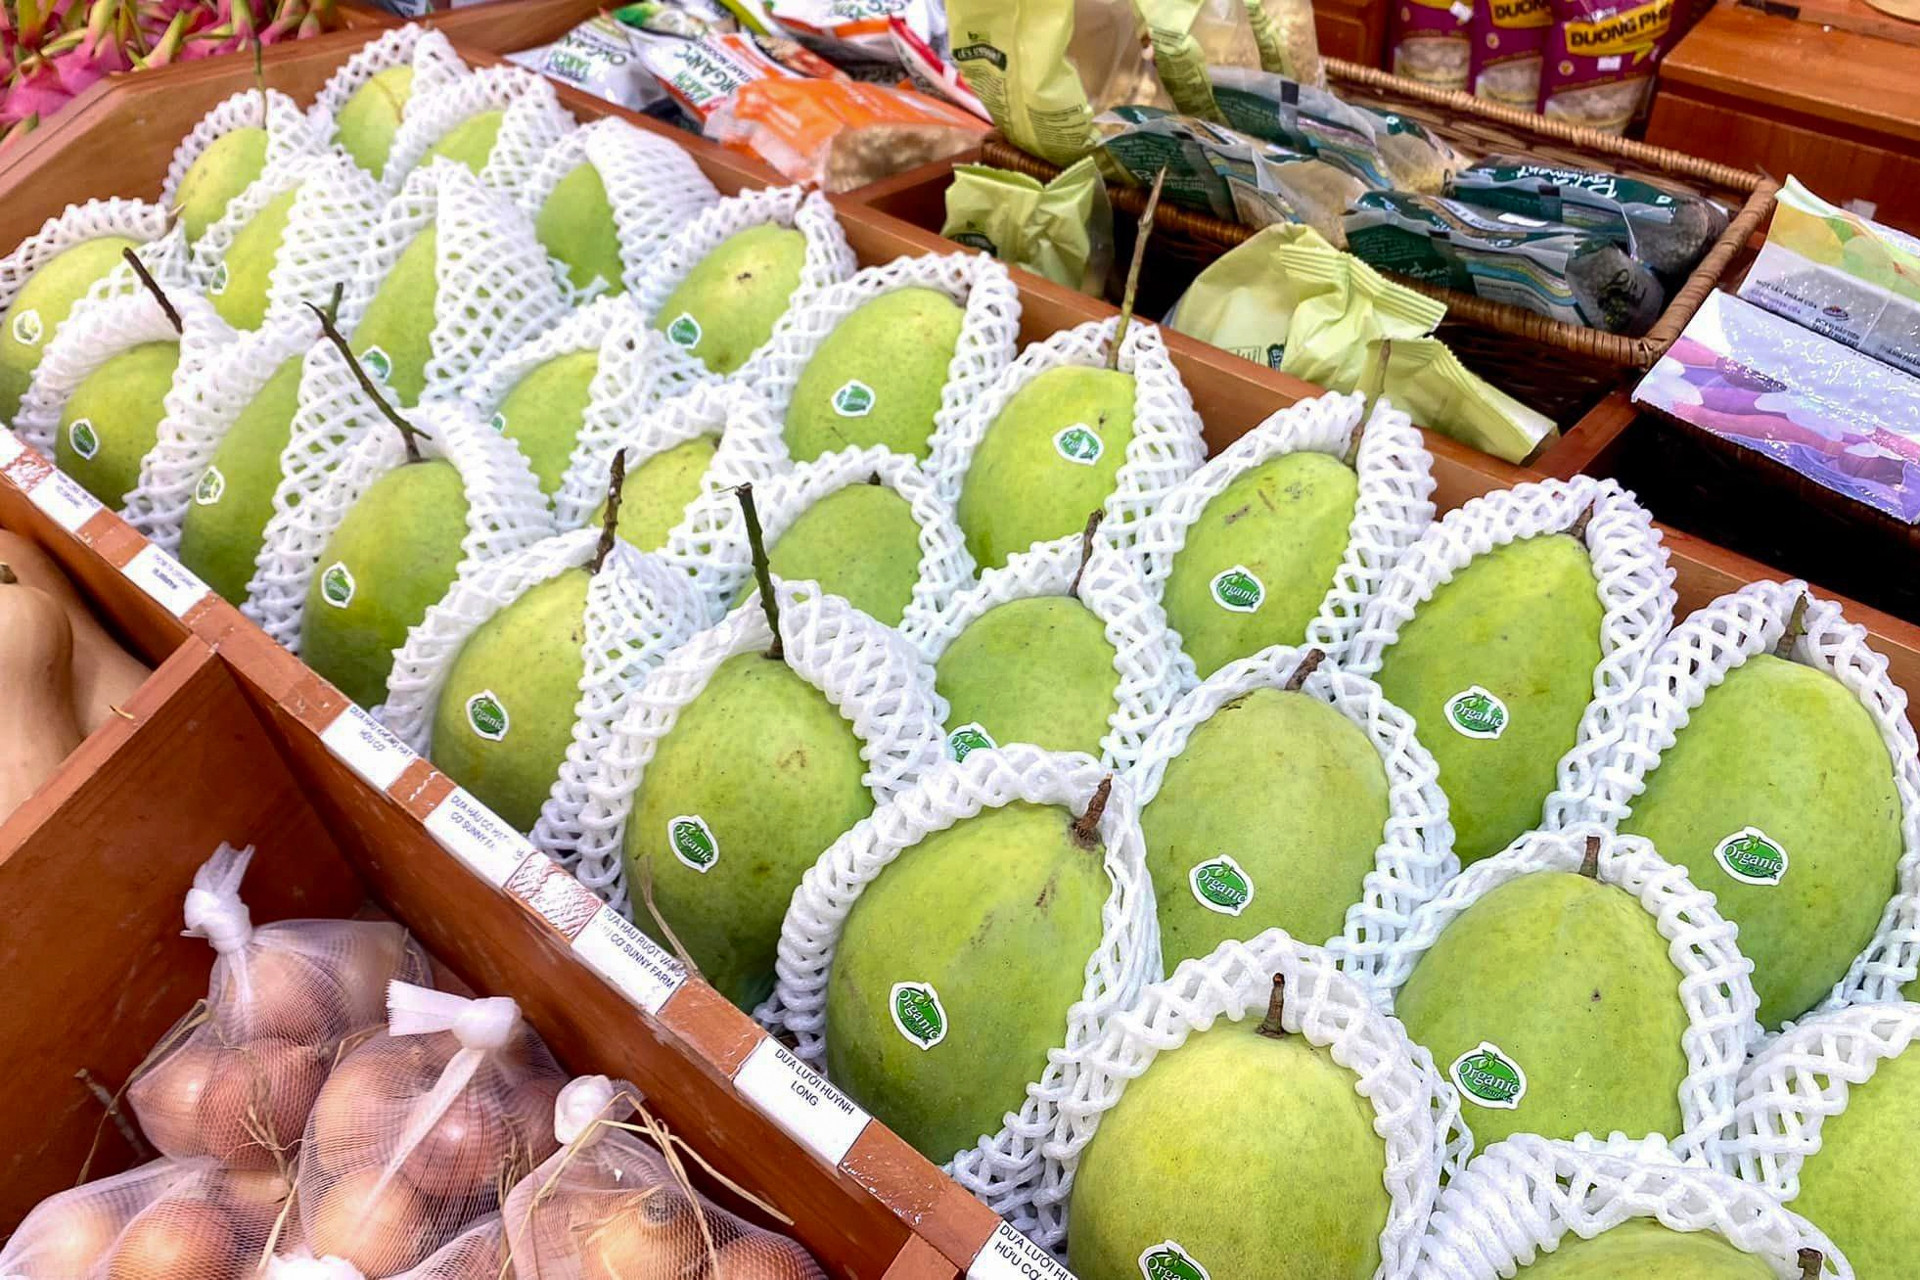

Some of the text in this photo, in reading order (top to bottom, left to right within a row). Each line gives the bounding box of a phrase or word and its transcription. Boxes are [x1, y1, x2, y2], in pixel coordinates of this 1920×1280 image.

[673, 823, 713, 862] Organic
[1723, 844, 1785, 872] Organic
[1196, 868, 1247, 904] Organic
[623, 943, 653, 969] SUNNY
[649, 965, 676, 990] FARM
[898, 988, 941, 1040] Organic
[790, 1080, 819, 1107] LONG
[1457, 1060, 1521, 1094] Organic
[1000, 1224, 1025, 1250] DƯA
